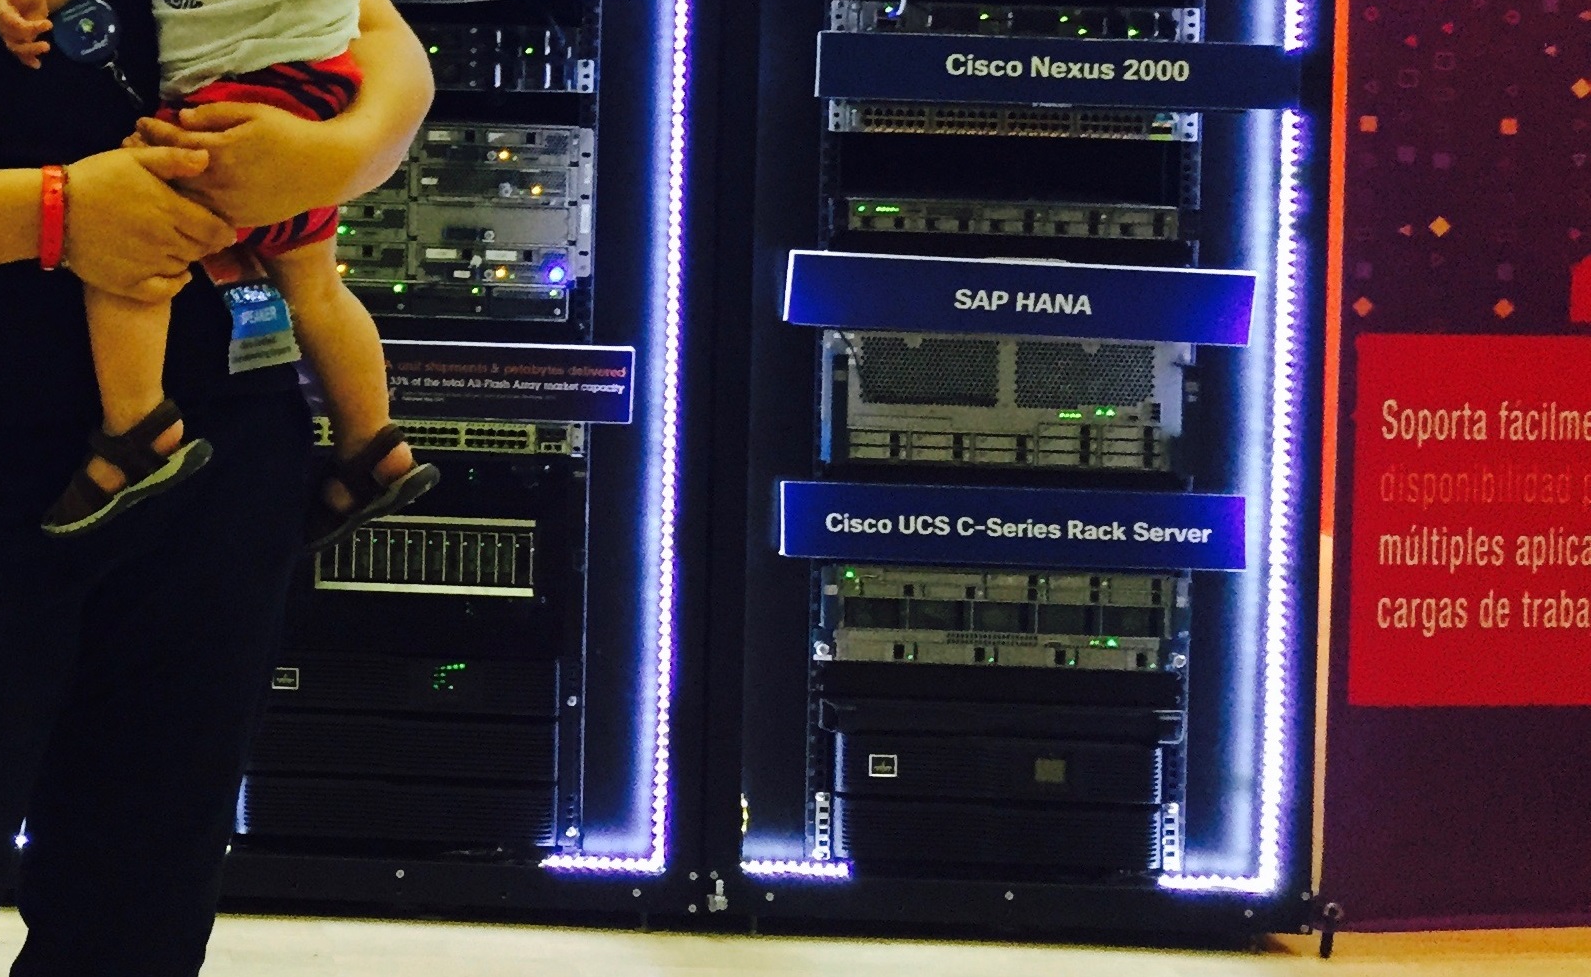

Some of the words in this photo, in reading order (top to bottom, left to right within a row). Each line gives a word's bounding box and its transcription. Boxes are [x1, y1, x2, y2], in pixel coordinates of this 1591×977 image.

[945, 53, 1023, 77] Cisco
[1030, 55, 1116, 80] Nexus
[1122, 58, 1190, 83] 2000
[953, 288, 1010, 311] SAP
[1014, 291, 1092, 315] HANA
[512, 380, 542, 392] Array
[544, 381, 579, 392] market
[580, 382, 625, 395] capacity
[568, 365, 627, 379] delivered
[1381, 399, 1488, 448] Soporta
[1379, 465, 1572, 510] disponibilidad
[824, 512, 893, 534] Cisco
[898, 515, 951, 536] UCS
[956, 516, 1062, 540] C-Series
[1067, 519, 1127, 543] Rack
[1133, 522, 1213, 545] Server
[1378, 525, 1505, 574] múltiples
[1377, 595, 1468, 637] cargas
[1479, 589, 1510, 629] de
[1522, 589, 1591, 629] traba
